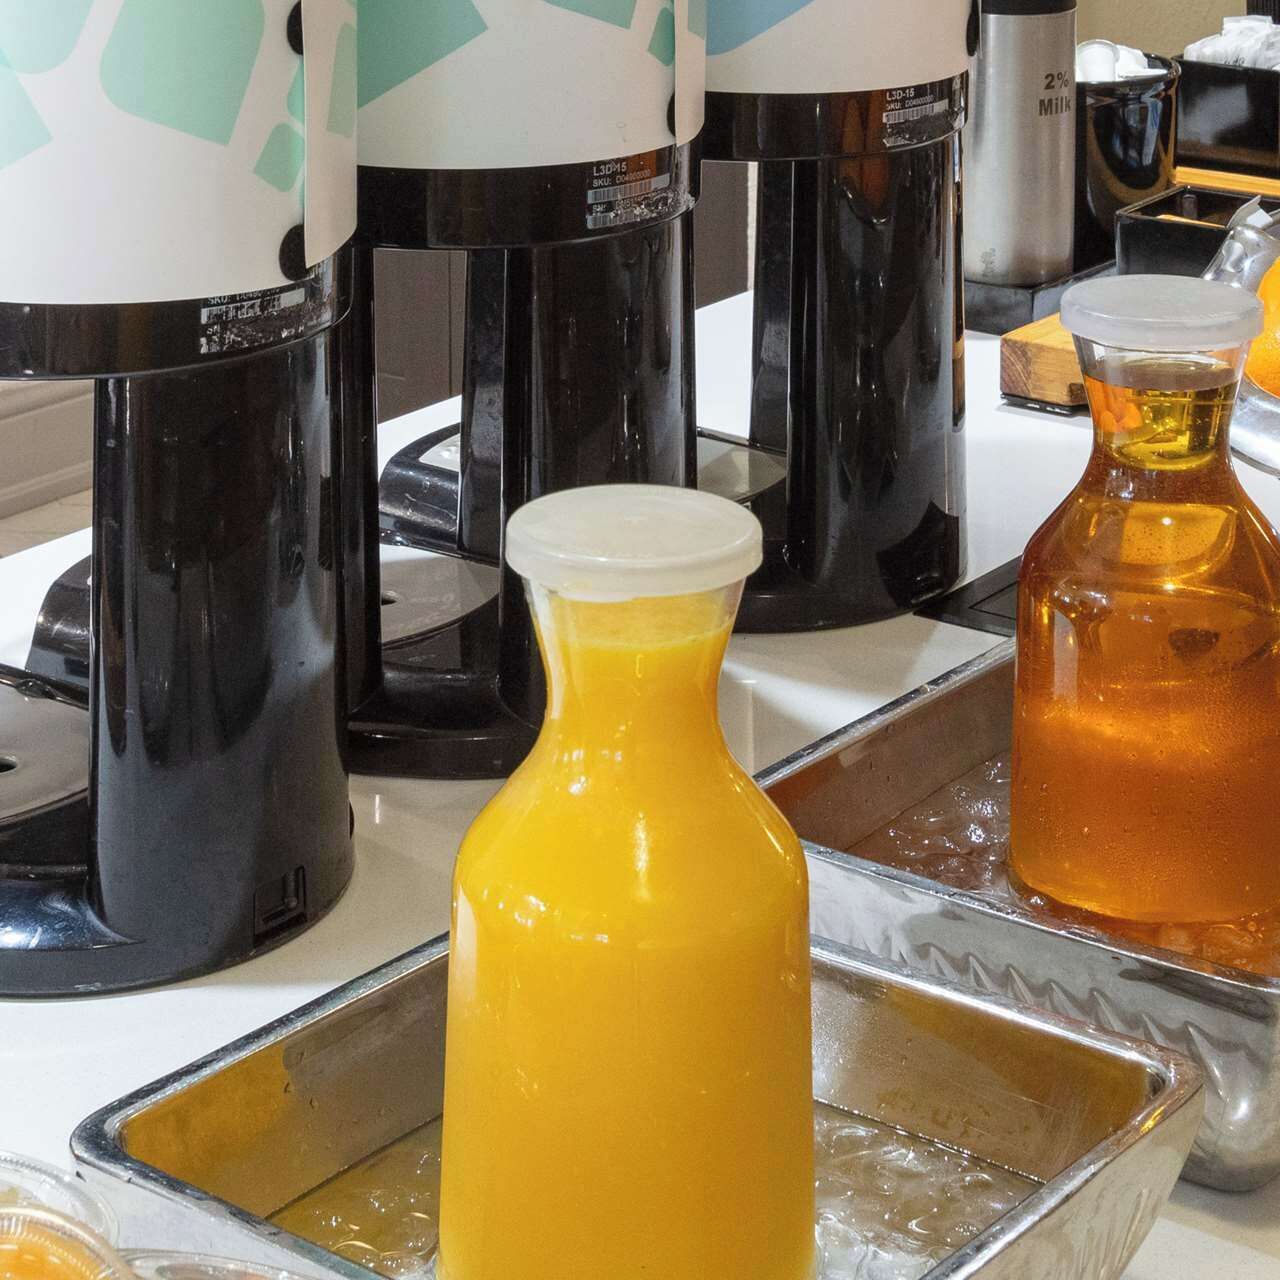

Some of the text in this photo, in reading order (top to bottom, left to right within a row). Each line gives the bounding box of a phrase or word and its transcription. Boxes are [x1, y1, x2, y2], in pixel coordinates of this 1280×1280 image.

[1044, 71, 1071, 91] 2%
[886, 88, 915, 101] L3D-15
[1038, 95, 1072, 118] Milk
[592, 178, 612, 187] SKU:
